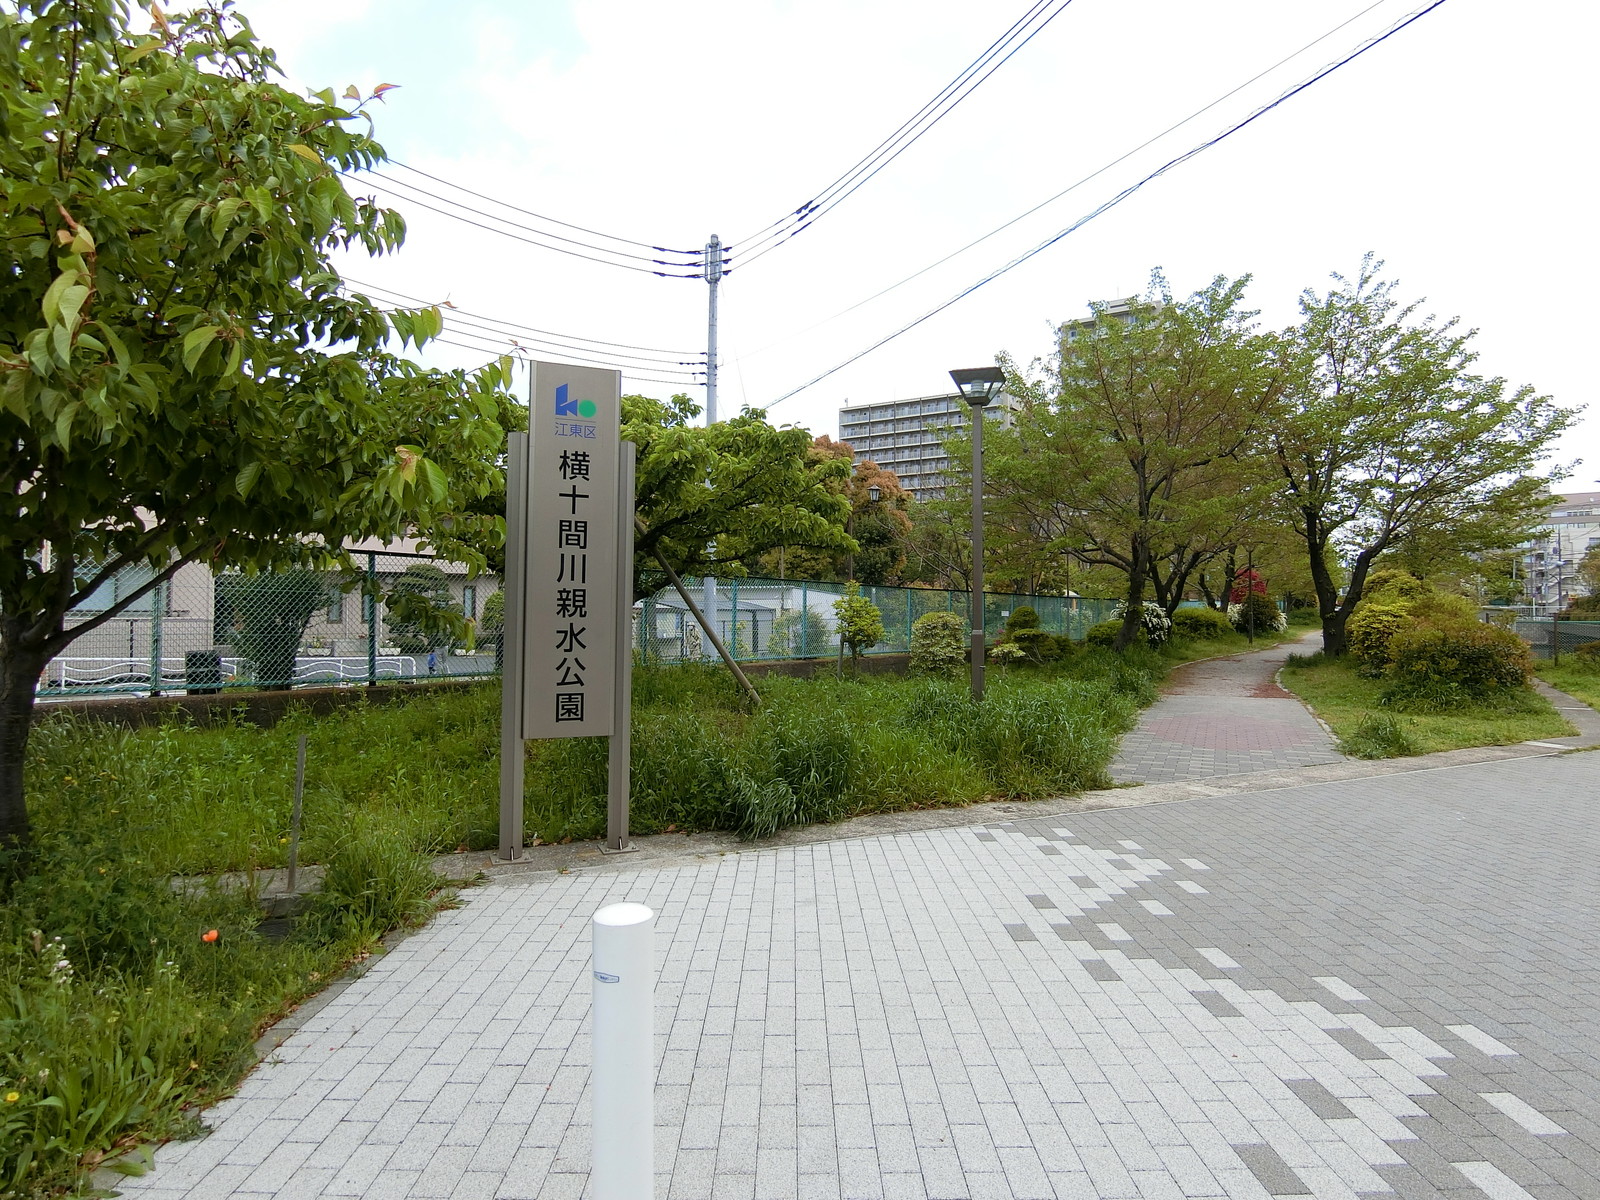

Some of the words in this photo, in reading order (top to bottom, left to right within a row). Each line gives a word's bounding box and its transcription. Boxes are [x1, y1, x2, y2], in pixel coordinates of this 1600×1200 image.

[554, 421, 597, 440] 江東区
[555, 449, 591, 723] 横十間川親水公園
